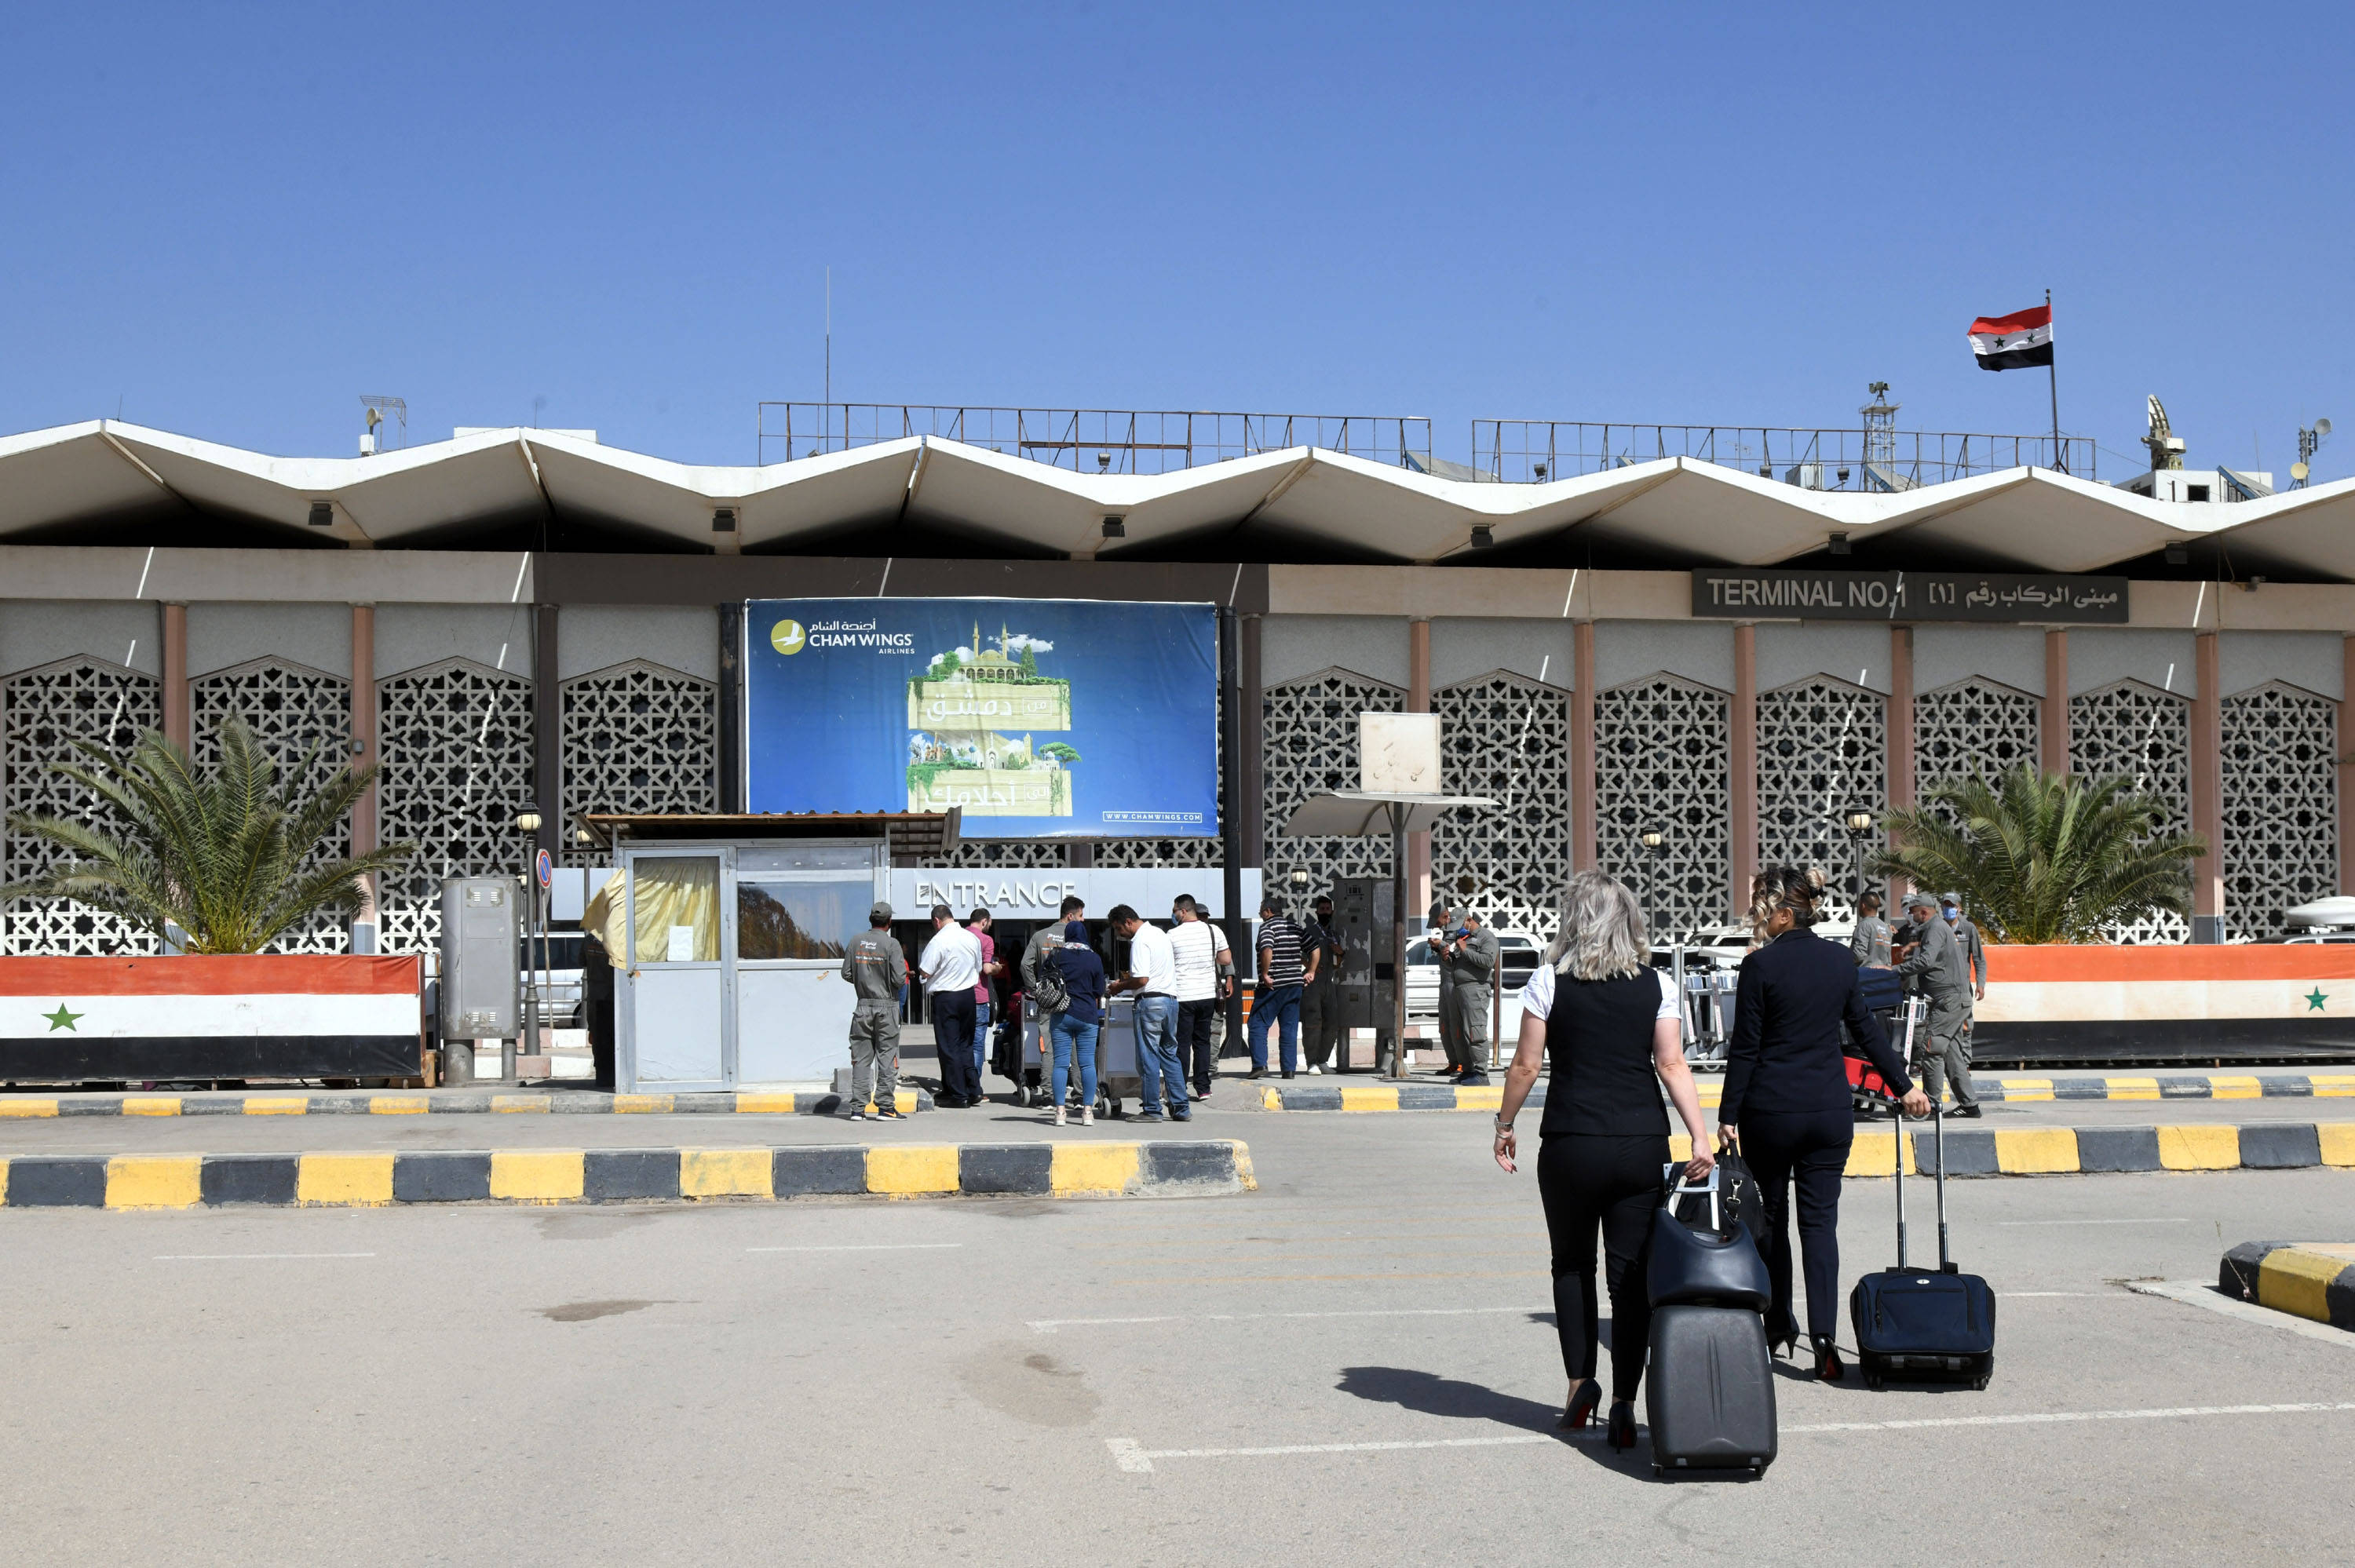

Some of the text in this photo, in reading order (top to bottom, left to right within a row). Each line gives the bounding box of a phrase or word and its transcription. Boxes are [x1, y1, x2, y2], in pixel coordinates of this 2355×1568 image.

[1707, 578, 1842, 607] TERMINAL
[1966, 581, 1997, 609] رقم
[2000, 583, 2069, 608] الركاب
[809, 618, 876, 633] أجنحة الشام
[809, 634, 913, 647] CHAM WINGS
[926, 689, 1013, 722] دمشق
[925, 781, 1016, 807] أحلامك
[915, 880, 1076, 908] ENTRANCE
